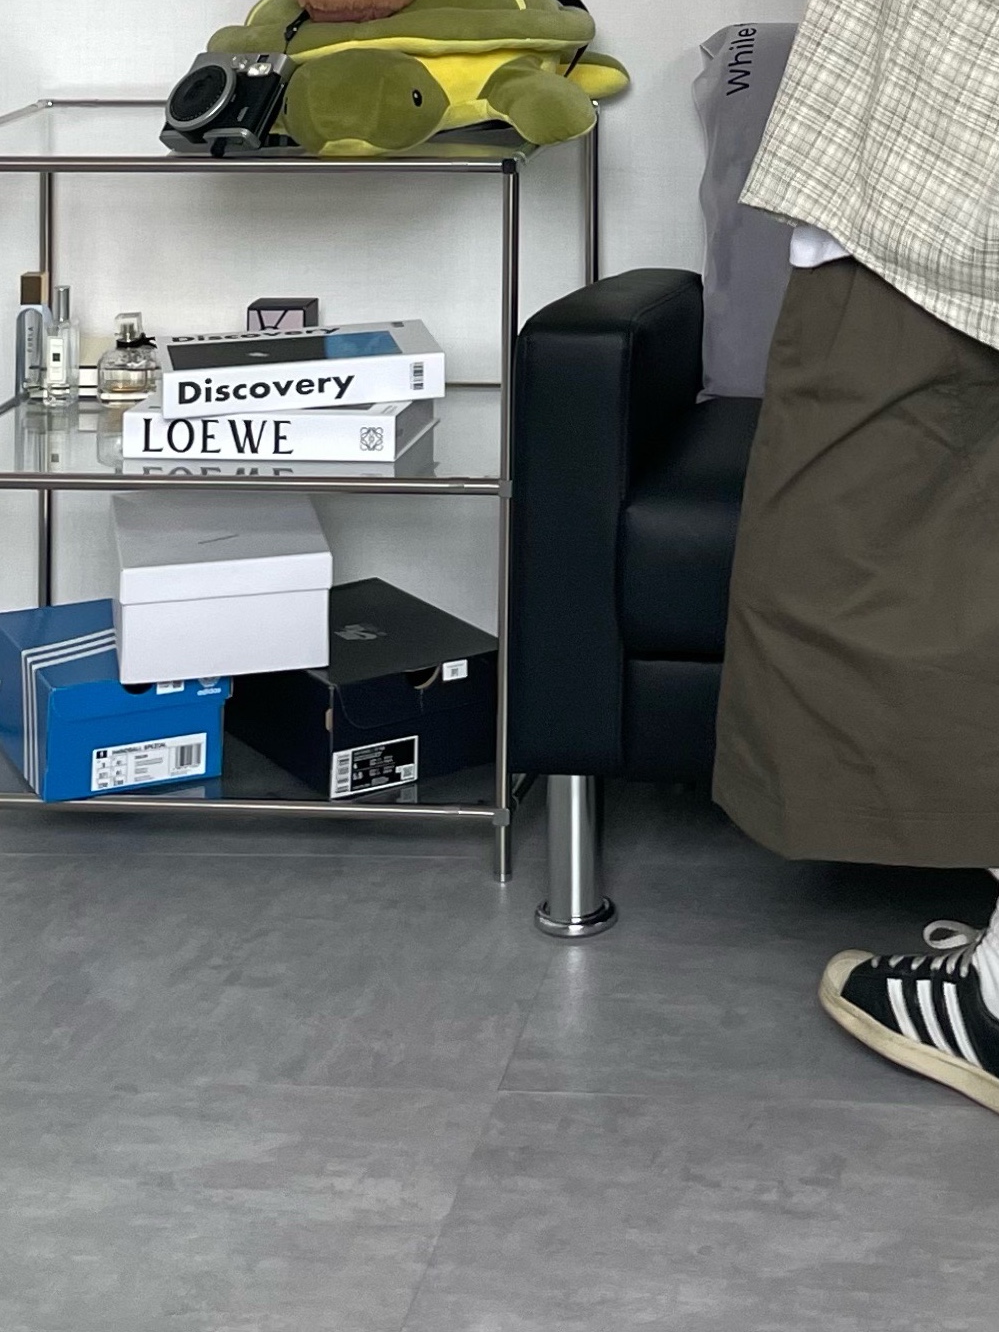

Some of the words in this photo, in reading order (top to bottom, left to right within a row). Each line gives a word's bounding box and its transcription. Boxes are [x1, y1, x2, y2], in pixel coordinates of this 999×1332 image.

[726, 27, 757, 96] While
[172, 327, 340, 343] Discovery
[178, 375, 355, 405] Discovery
[142, 418, 294, 454] LOEWE
